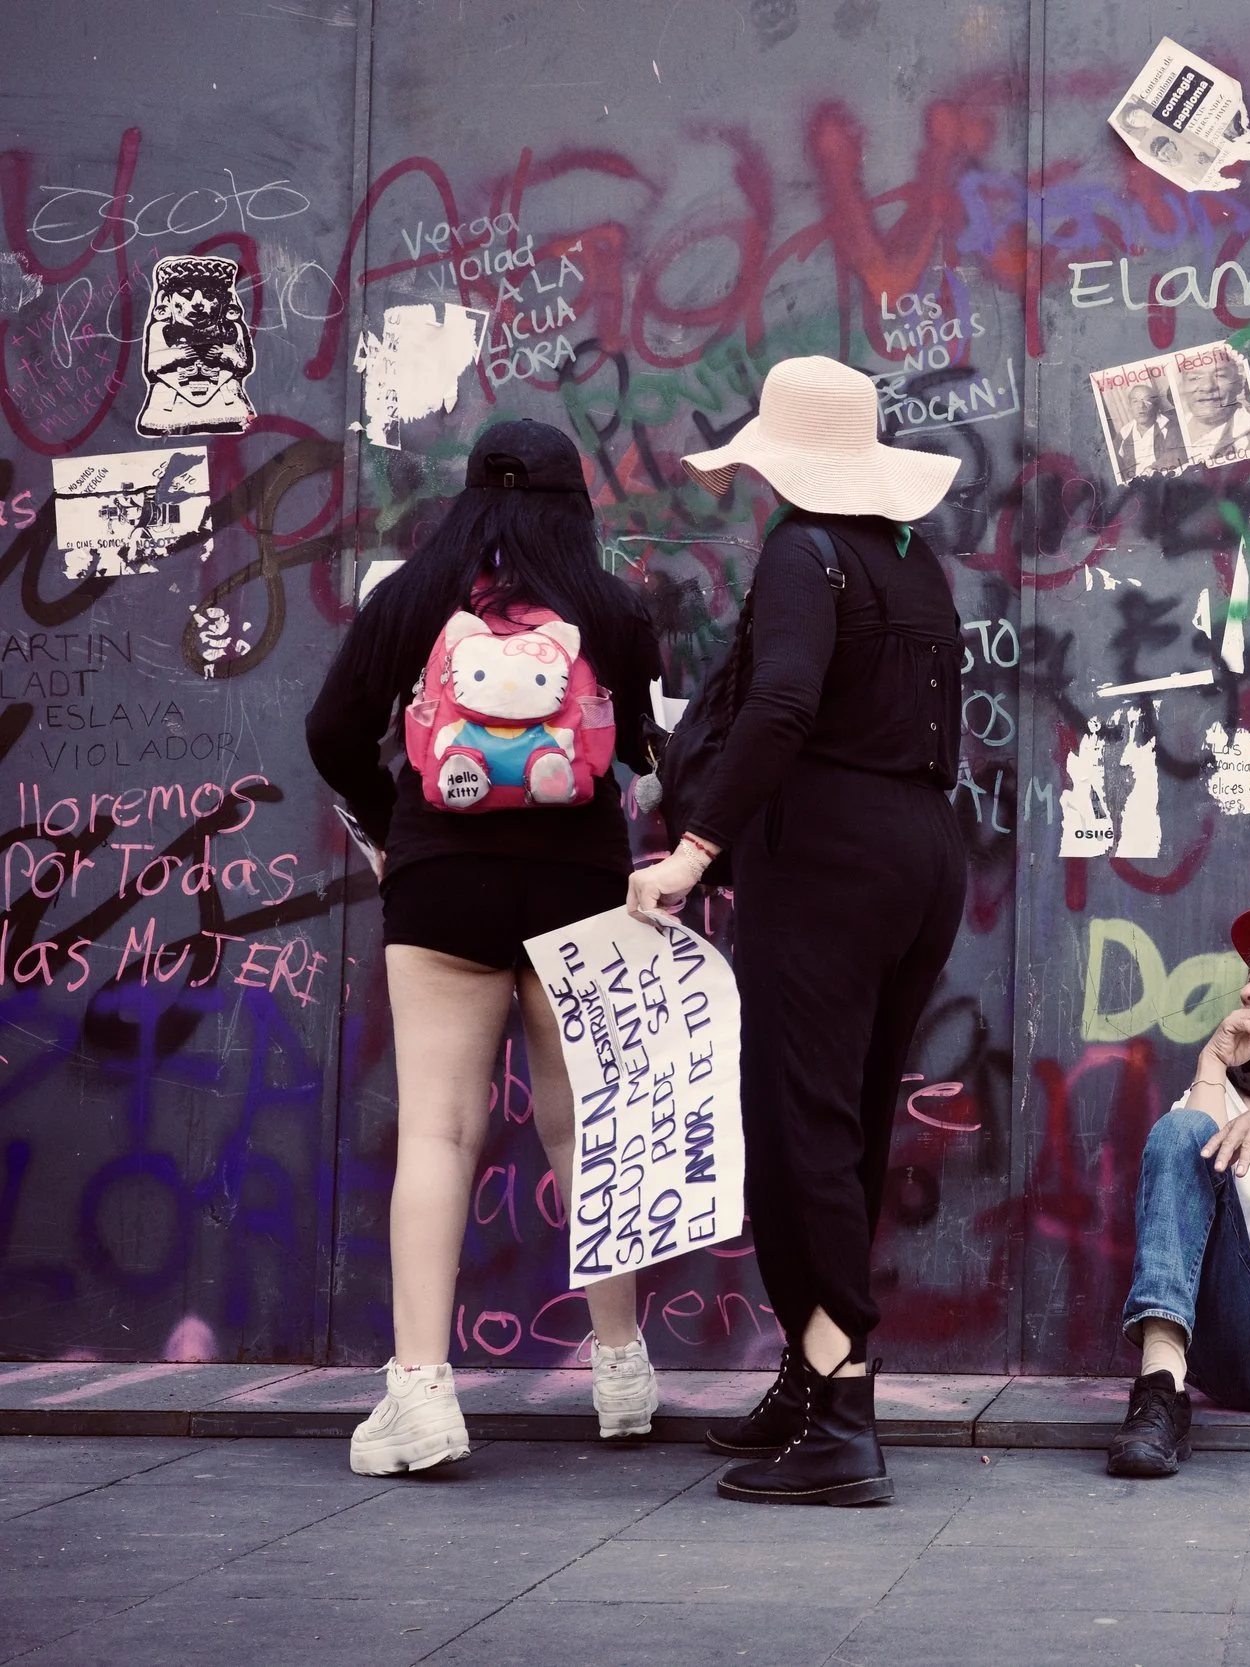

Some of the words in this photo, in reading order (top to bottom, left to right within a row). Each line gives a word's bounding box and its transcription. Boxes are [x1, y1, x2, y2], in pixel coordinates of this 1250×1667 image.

[1151, 71, 1176, 107] papiloma
[1161, 72, 1195, 118] contagia
[1173, 80, 1209, 130] papiloma
[1068, 257, 1142, 310] El
[487, 296, 577, 354] LICUA
[884, 313, 986, 353] niñas
[485, 334, 577, 387] DORA
[904, 345, 950, 371] NO
[46, 701, 185, 731] ESLAVA
[41, 732, 240, 772] VIOLADOR
[1212, 743, 1242, 756] Las
[447, 771, 478, 785] Hello
[447, 785, 479, 799] Kitty
[19, 774, 270, 837] lloremos
[558, 941, 588, 978] TU
[548, 976, 587, 1043] QUE
[637, 954, 671, 1036] SER
[681, 991, 712, 1039] TU
[576, 979, 622, 1087] DESTRUYE
[600, 940, 652, 1108] MENTAL
[688, 1040, 713, 1085] DE
[651, 1061, 677, 1164] PUEDE
[684, 1095, 717, 1184] AMOR
[573, 1082, 621, 1276] ALGUIEN
[615, 1134, 646, 1266] SALUD
[648, 1188, 682, 1259] NO
[688, 1196, 717, 1243] EL
